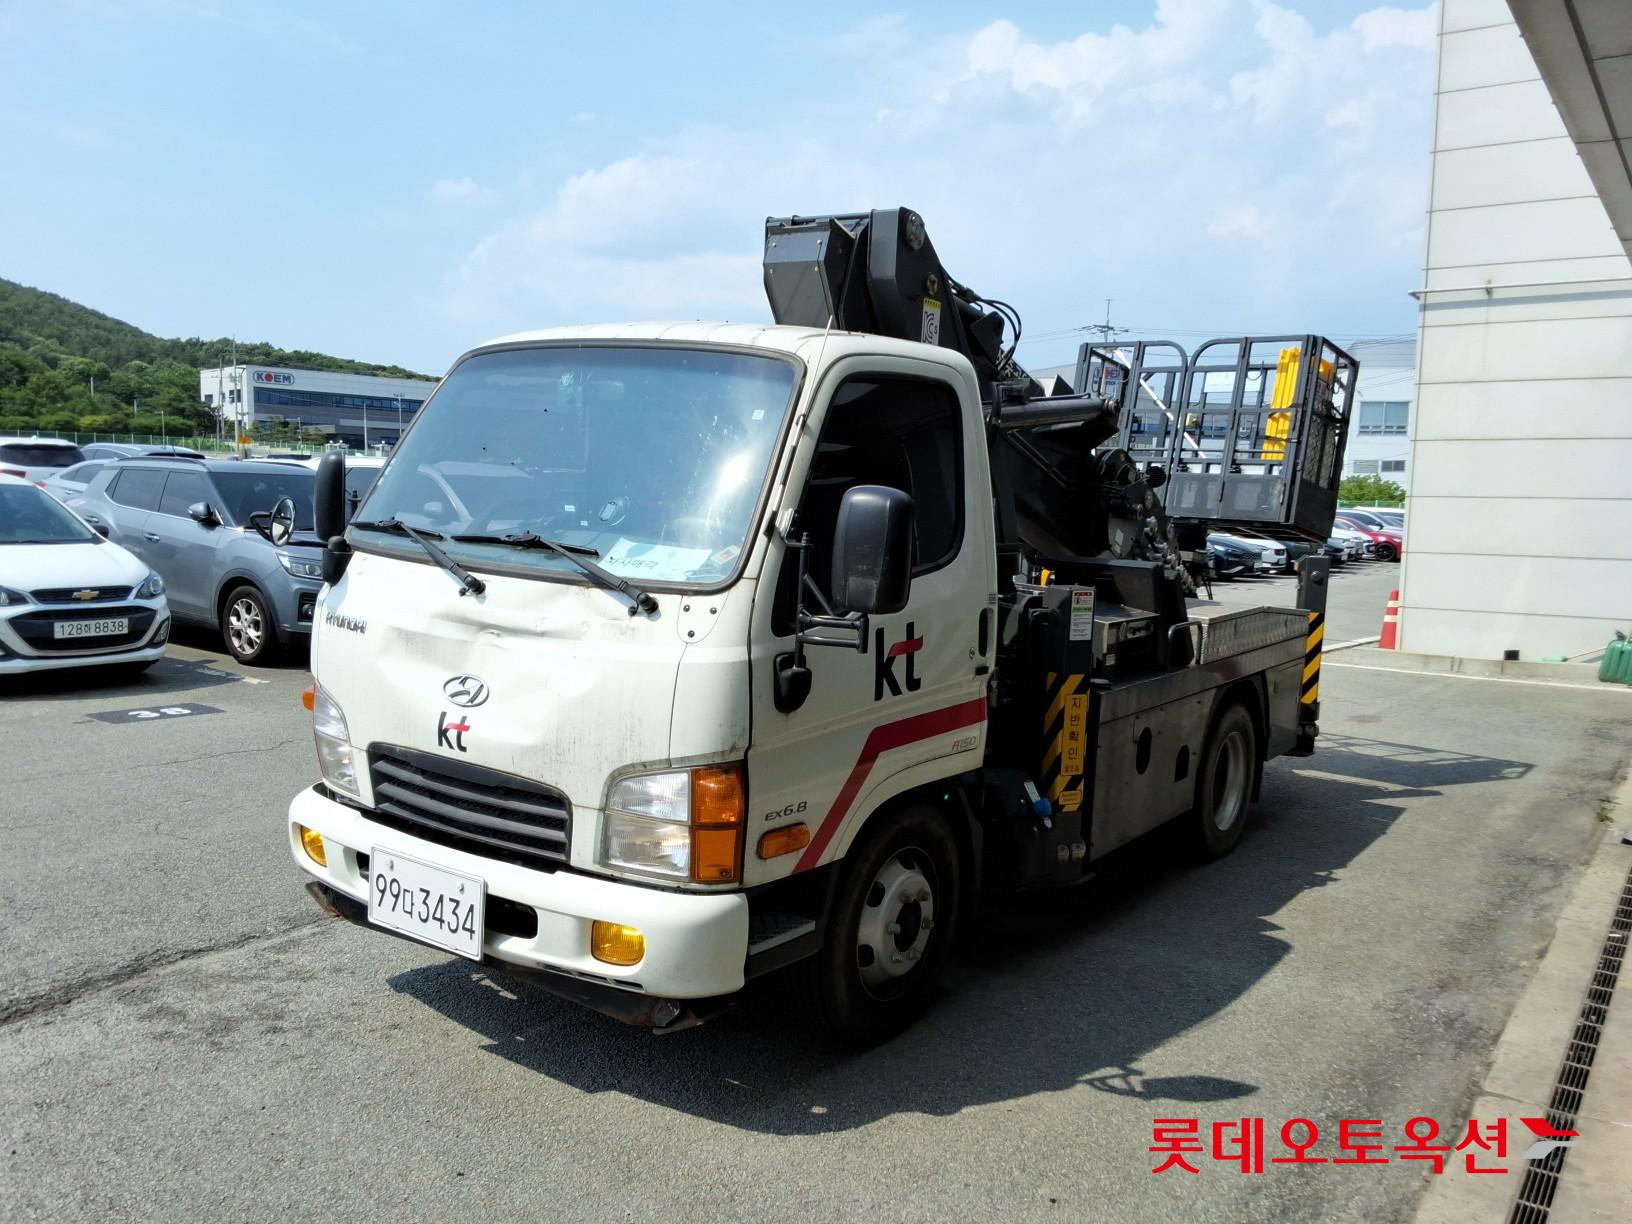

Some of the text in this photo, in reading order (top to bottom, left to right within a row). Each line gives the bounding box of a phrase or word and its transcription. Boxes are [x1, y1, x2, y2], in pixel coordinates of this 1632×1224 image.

[94, 620, 124, 634] 8838
[874, 621, 924, 702] kt
[437, 711, 471, 753] kt
[764, 801, 808, 822] EX6.8
